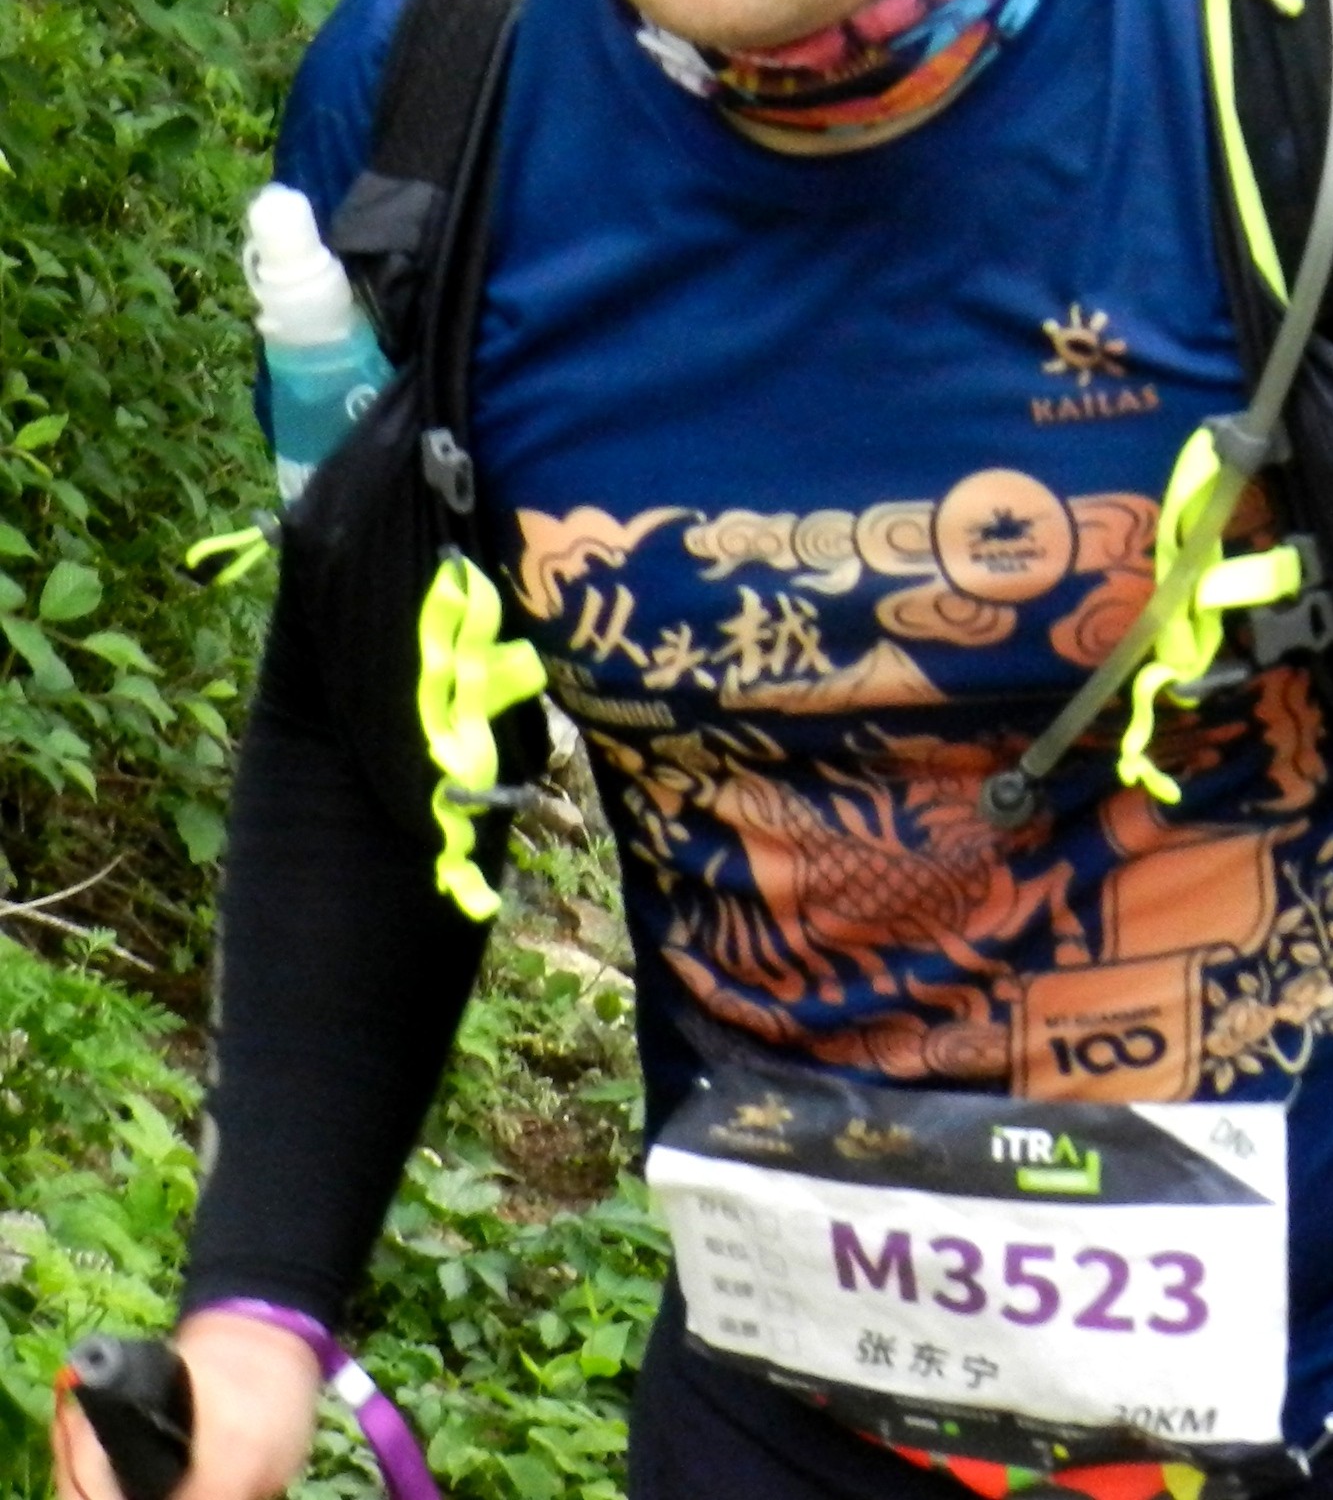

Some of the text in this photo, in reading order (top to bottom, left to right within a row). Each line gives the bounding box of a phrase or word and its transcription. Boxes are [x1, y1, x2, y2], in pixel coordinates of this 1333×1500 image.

[830, 1219, 1210, 1336] M3523
[855, 1327, 999, 1390] 张东宁
